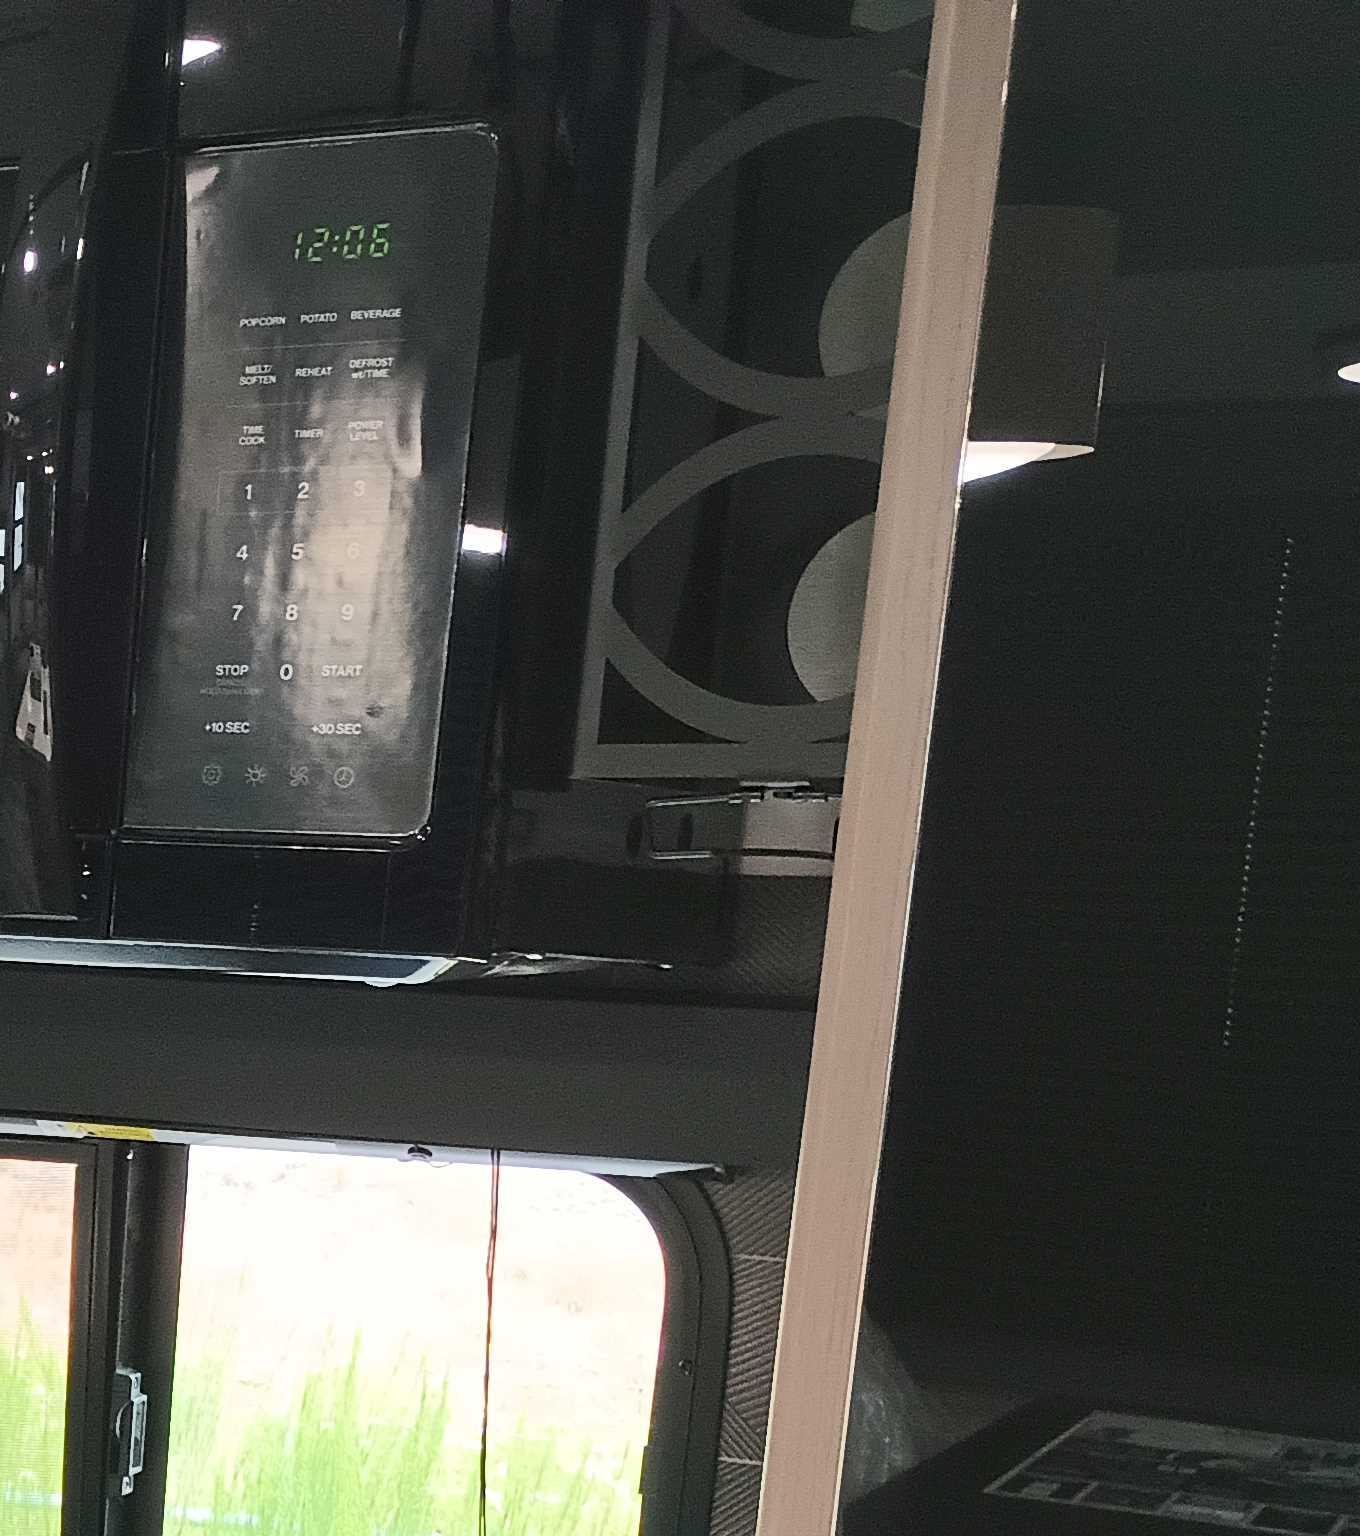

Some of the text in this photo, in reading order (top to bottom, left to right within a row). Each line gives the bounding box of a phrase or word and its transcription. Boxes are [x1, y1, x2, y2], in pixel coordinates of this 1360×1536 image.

[294, 221, 392, 263] 12:06
[239, 308, 402, 328] POPCORN POTATO BEVERAGE
[295, 366, 333, 377] REHEAT
[349, 357, 394, 369] DEFROST
[240, 375, 277, 386] SOFTEN
[294, 428, 323, 439] TIMER
[348, 420, 384, 431] POWER
[350, 430, 379, 441] LEVEL
[245, 483, 254, 500] 1
[296, 481, 311, 500] 2
[353, 479, 367, 498] 3
[236, 544, 250, 561] 4
[291, 543, 306, 560] 5
[347, 541, 361, 559] 6
[231, 603, 245, 621] 7
[285, 603, 299, 621] 8
[341, 603, 355, 621] 9
[215, 664, 250, 677] STOP
[279, 663, 294, 681] 0
[321, 664, 364, 677] START
[205, 721, 251, 734] +10 SEC
[312, 722, 363, 735] +30 SEC
